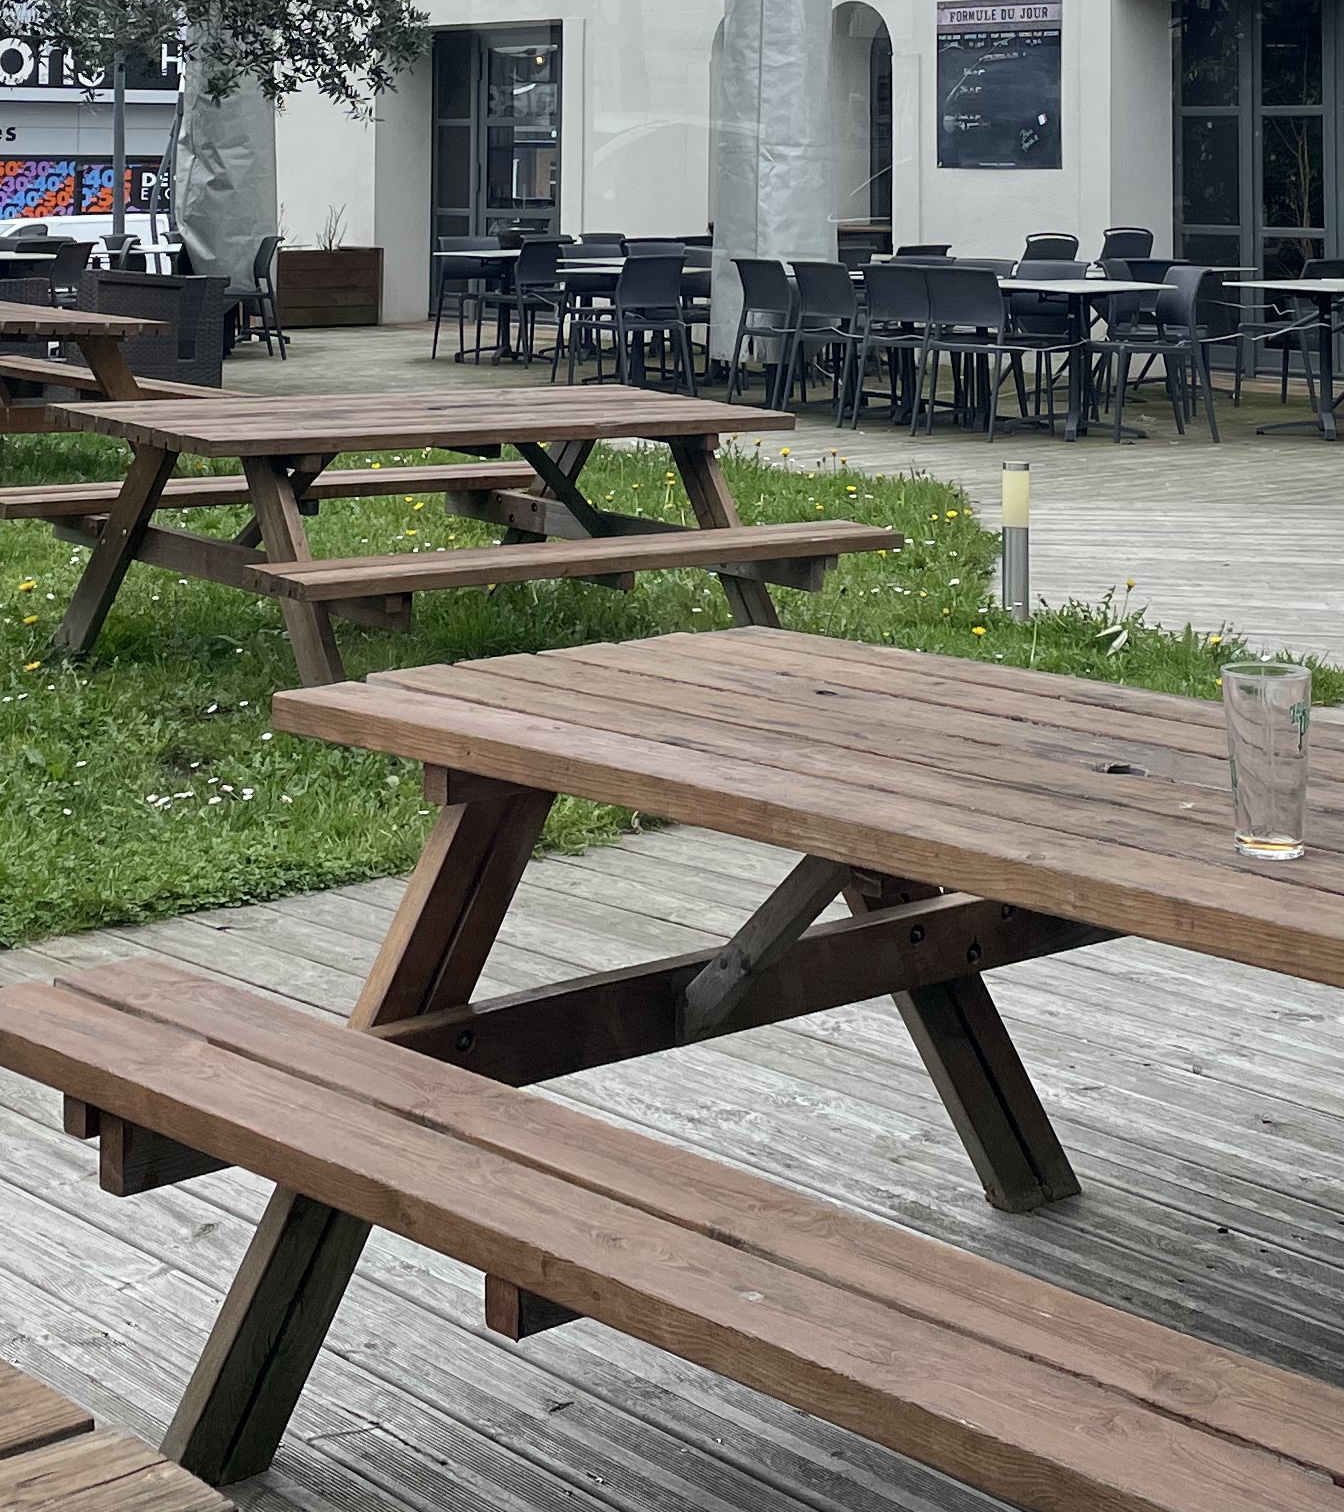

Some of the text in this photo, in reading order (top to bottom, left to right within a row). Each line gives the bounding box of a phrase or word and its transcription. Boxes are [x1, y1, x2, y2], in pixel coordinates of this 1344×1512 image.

[949, 6, 1049, 23] FORMULE DU JOUR
